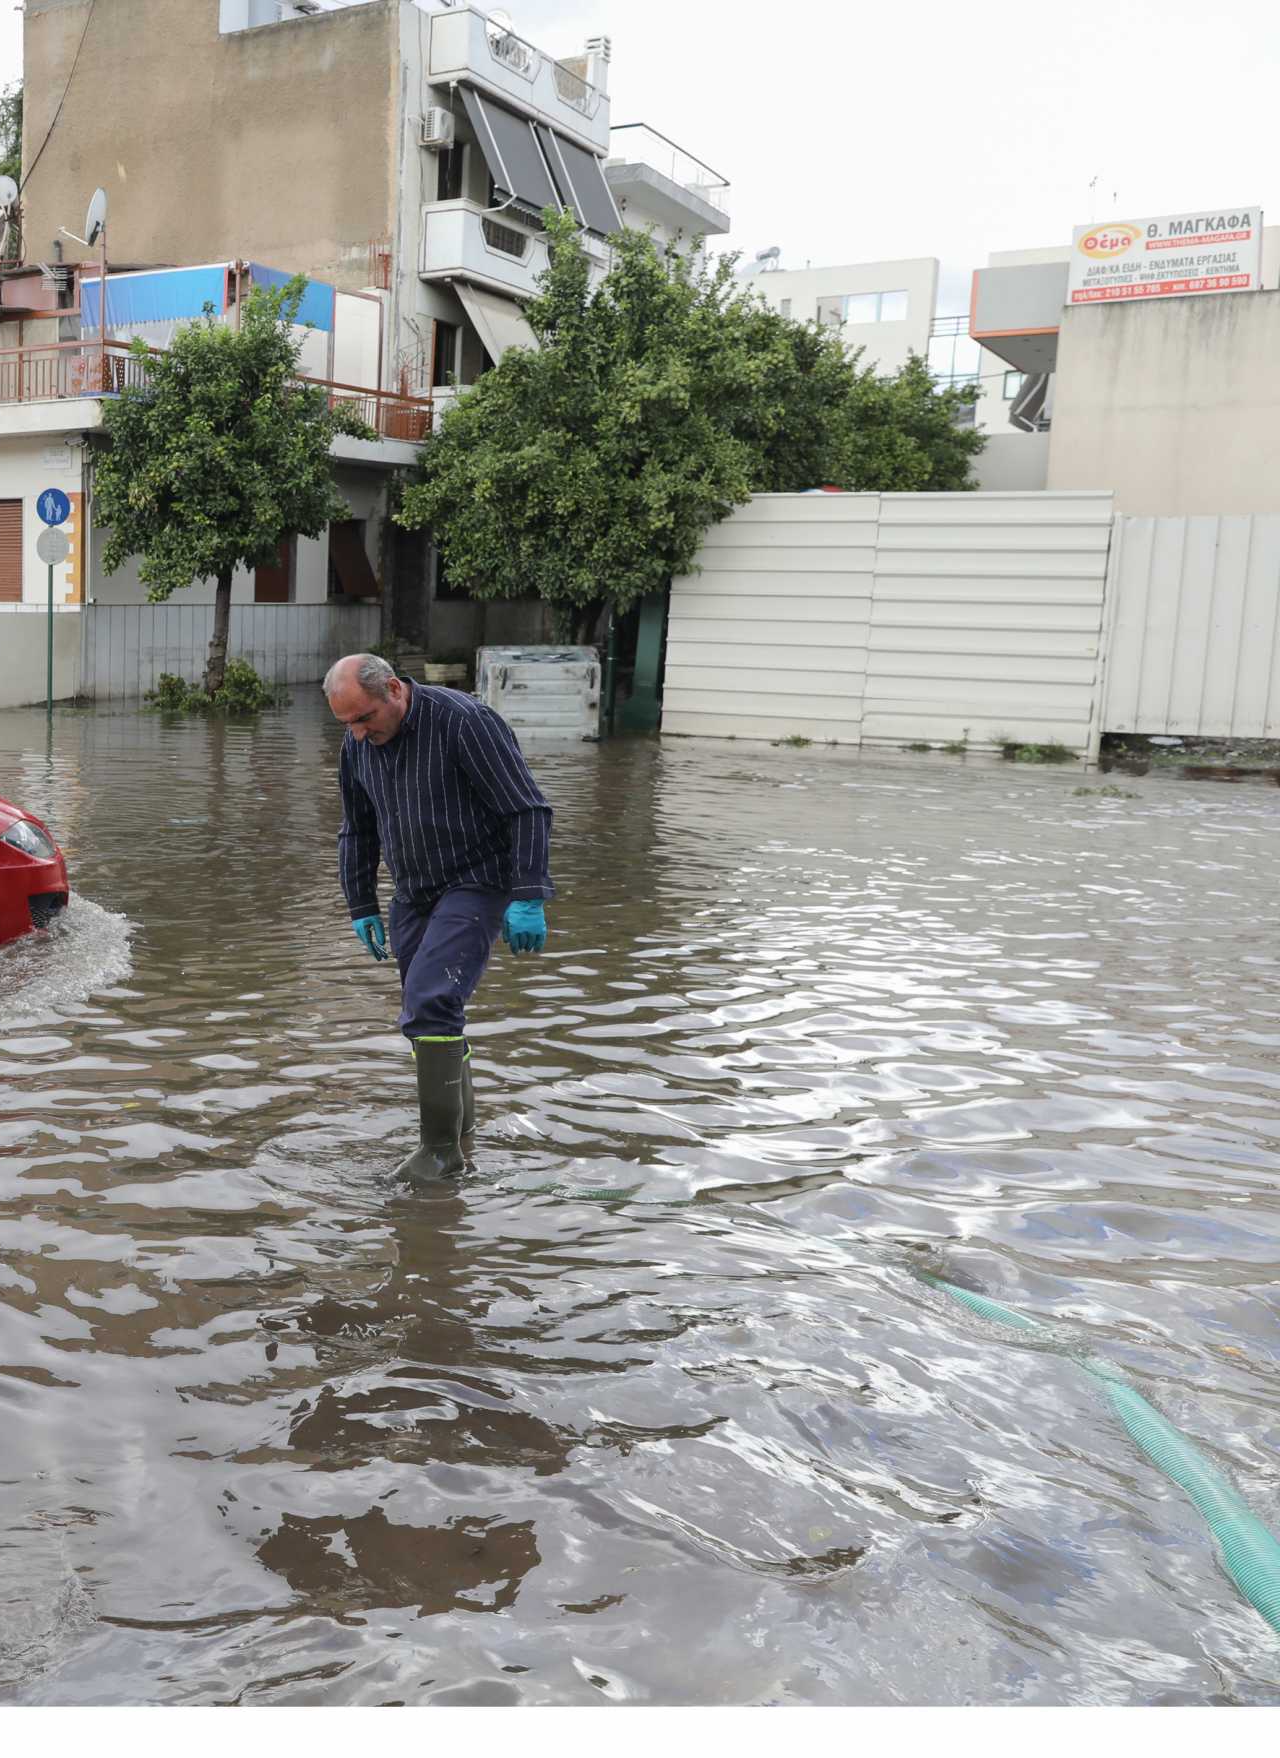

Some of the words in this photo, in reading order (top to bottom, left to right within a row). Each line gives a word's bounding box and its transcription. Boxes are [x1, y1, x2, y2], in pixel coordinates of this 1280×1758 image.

[1147, 224, 1163, 238] Θ.
[1169, 213, 1252, 236] ΜΑΓΚΑΦΑ
[1084, 234, 1131, 250] Θέμα
[1122, 261, 1141, 273] ΕΙΔΗ
[1149, 256, 1194, 270] ΕΝΔΥΜΑΤΑ
[1197, 252, 1237, 266] ΕΡΓΑΣΙΑΣ
